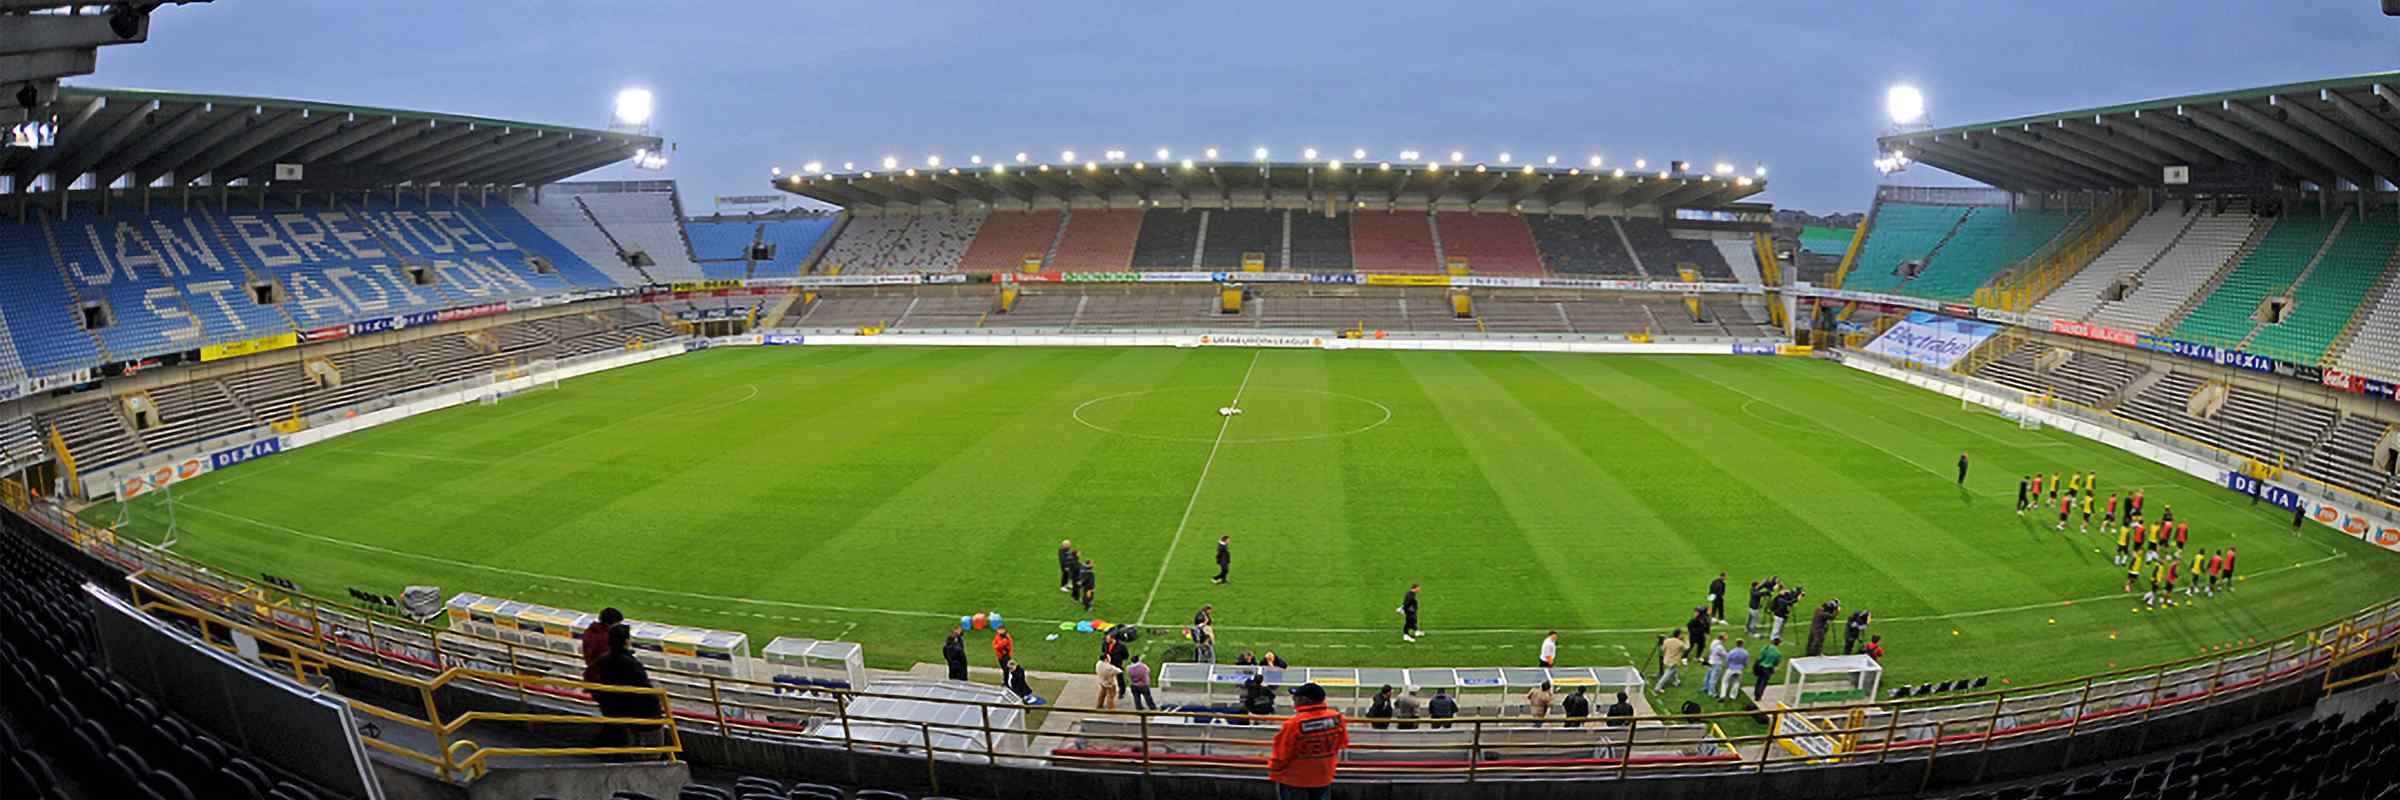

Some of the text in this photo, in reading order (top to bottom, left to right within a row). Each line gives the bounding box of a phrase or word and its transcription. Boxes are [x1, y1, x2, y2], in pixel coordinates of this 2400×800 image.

[69, 210, 519, 286] JAN BREYDEL
[2226, 352, 2269, 370] DEXIA
[218, 441, 274, 466] DEXIA
